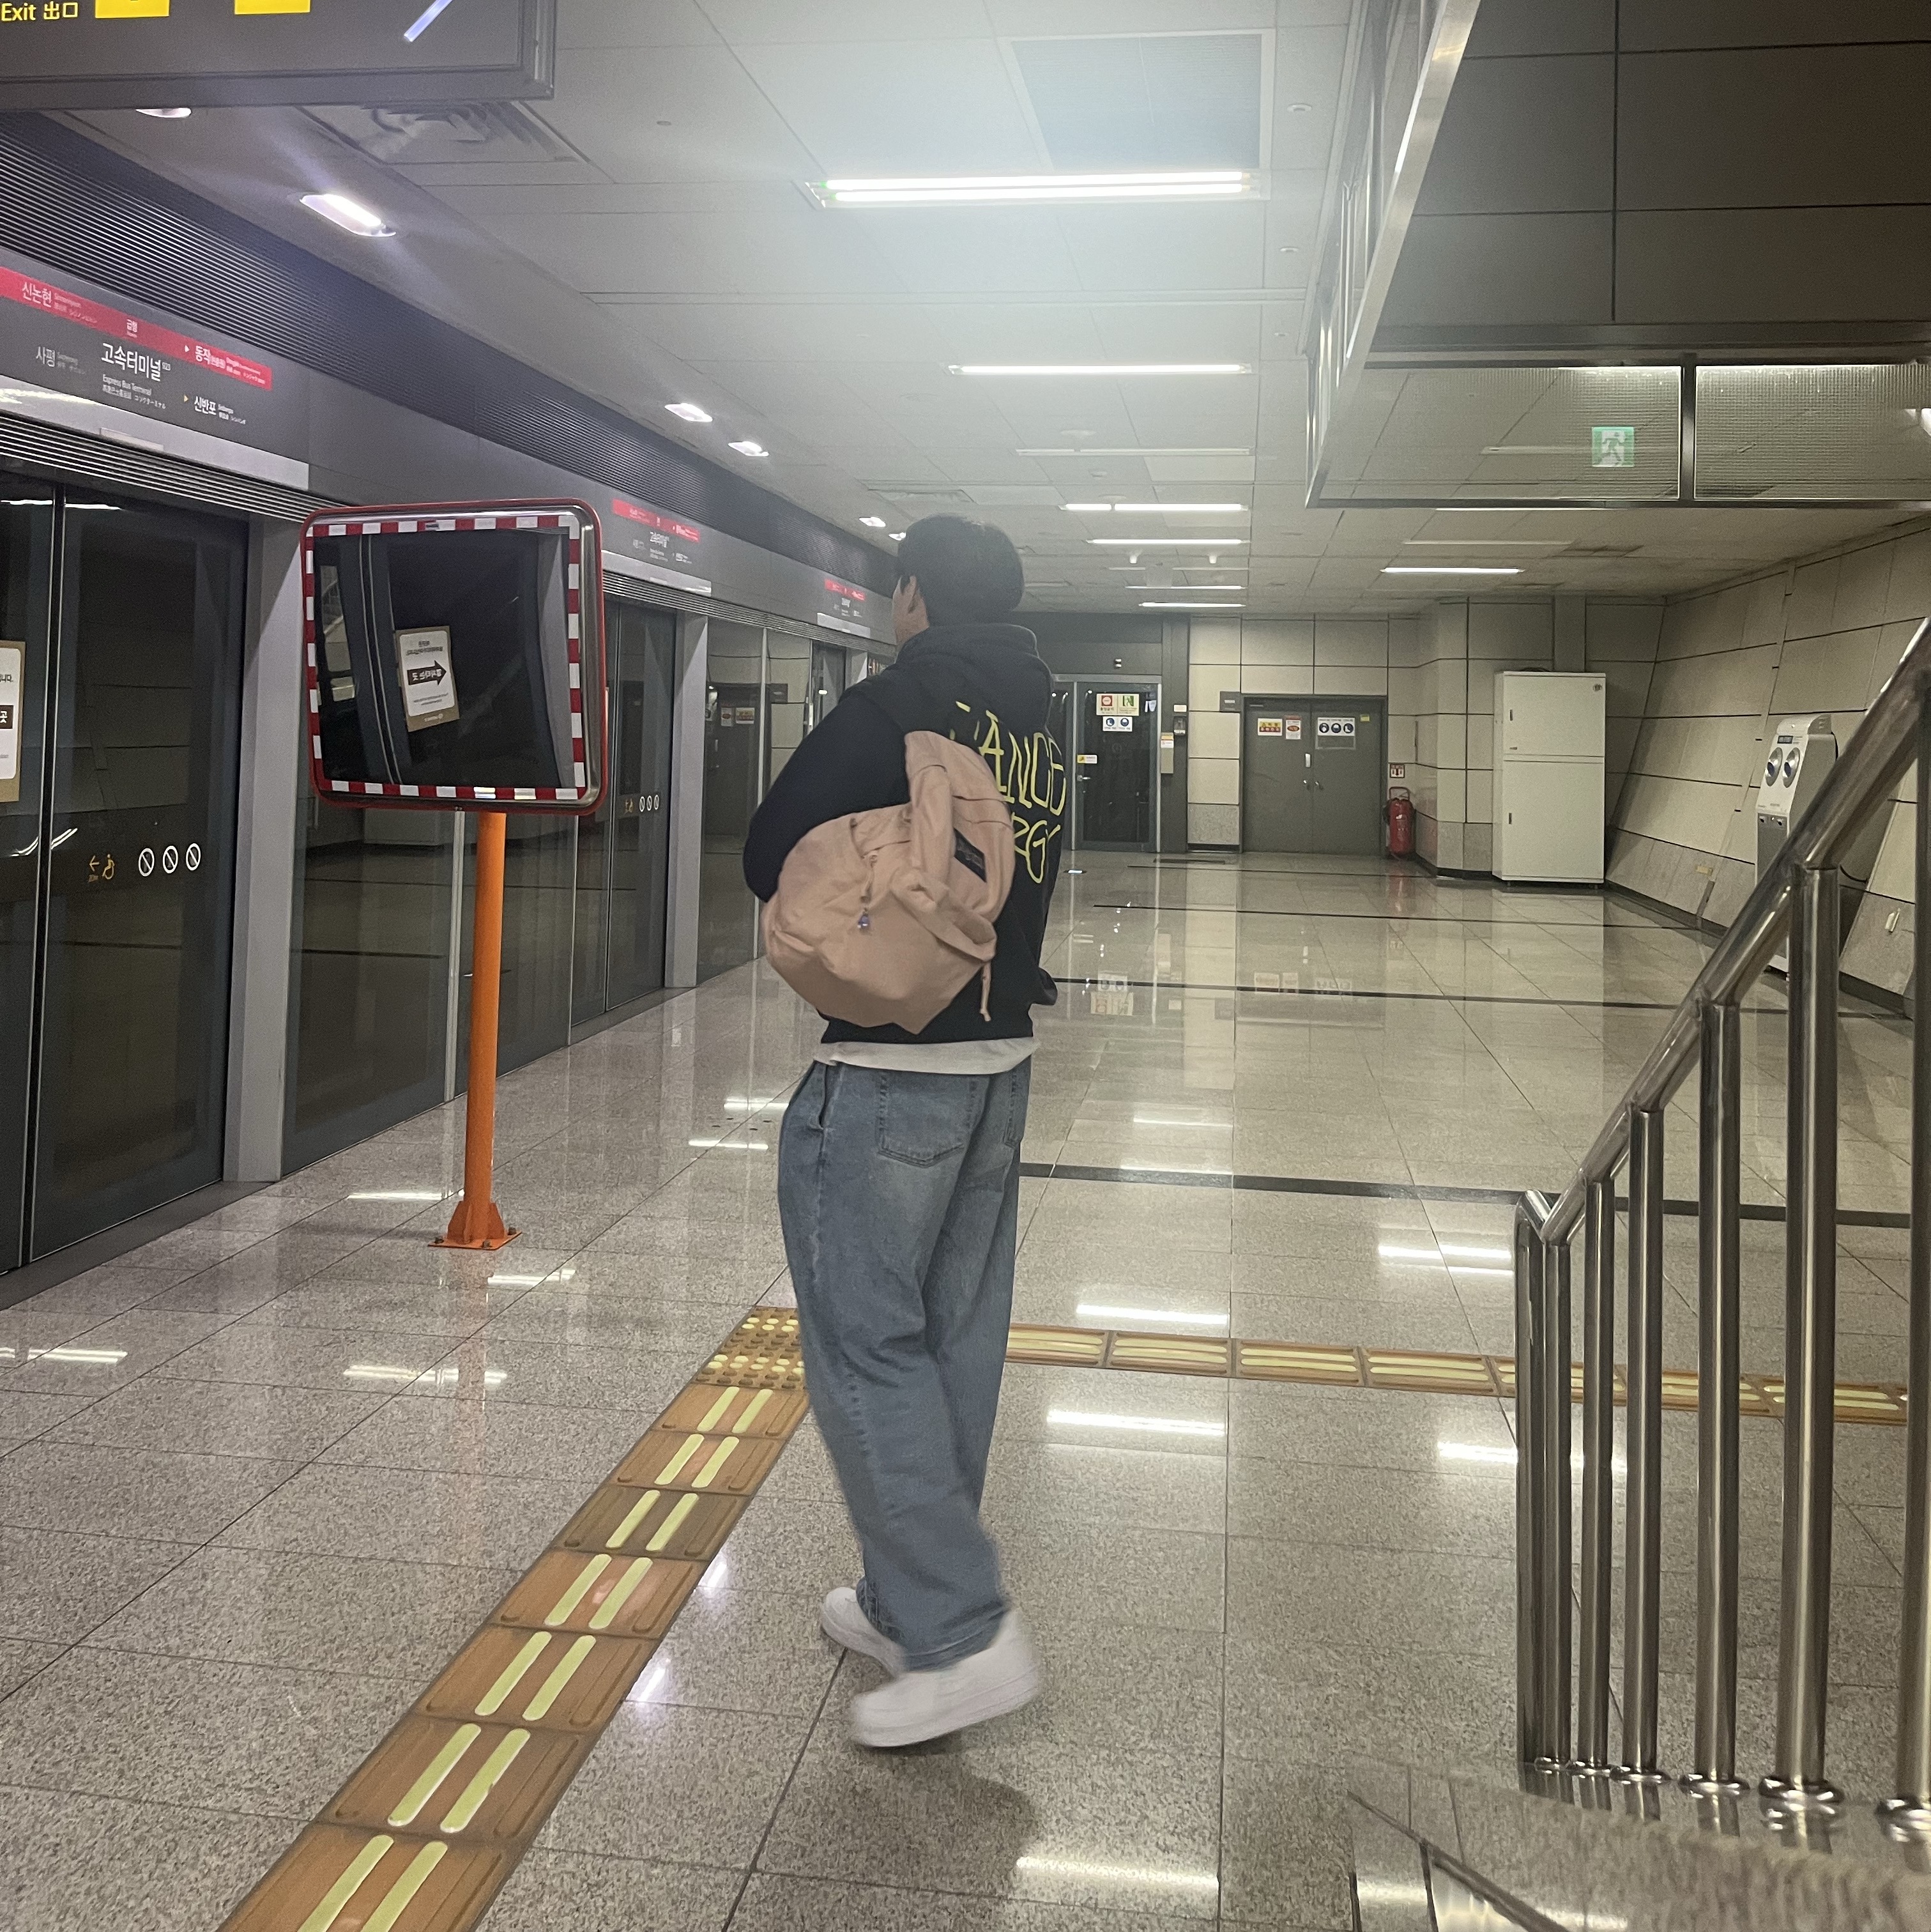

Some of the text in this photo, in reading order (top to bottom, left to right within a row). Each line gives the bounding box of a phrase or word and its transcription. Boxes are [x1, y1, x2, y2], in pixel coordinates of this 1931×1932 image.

[1, 1, 79, 21] Exit 出口
[22, 281, 52, 308] 신논현
[36, 346, 56, 367] 사평
[101, 342, 161, 382] 고속터미널
[195, 345, 211, 365] 동작
[194, 395, 217, 415] 신반포
[949, 701, 1066, 816] ANCE
